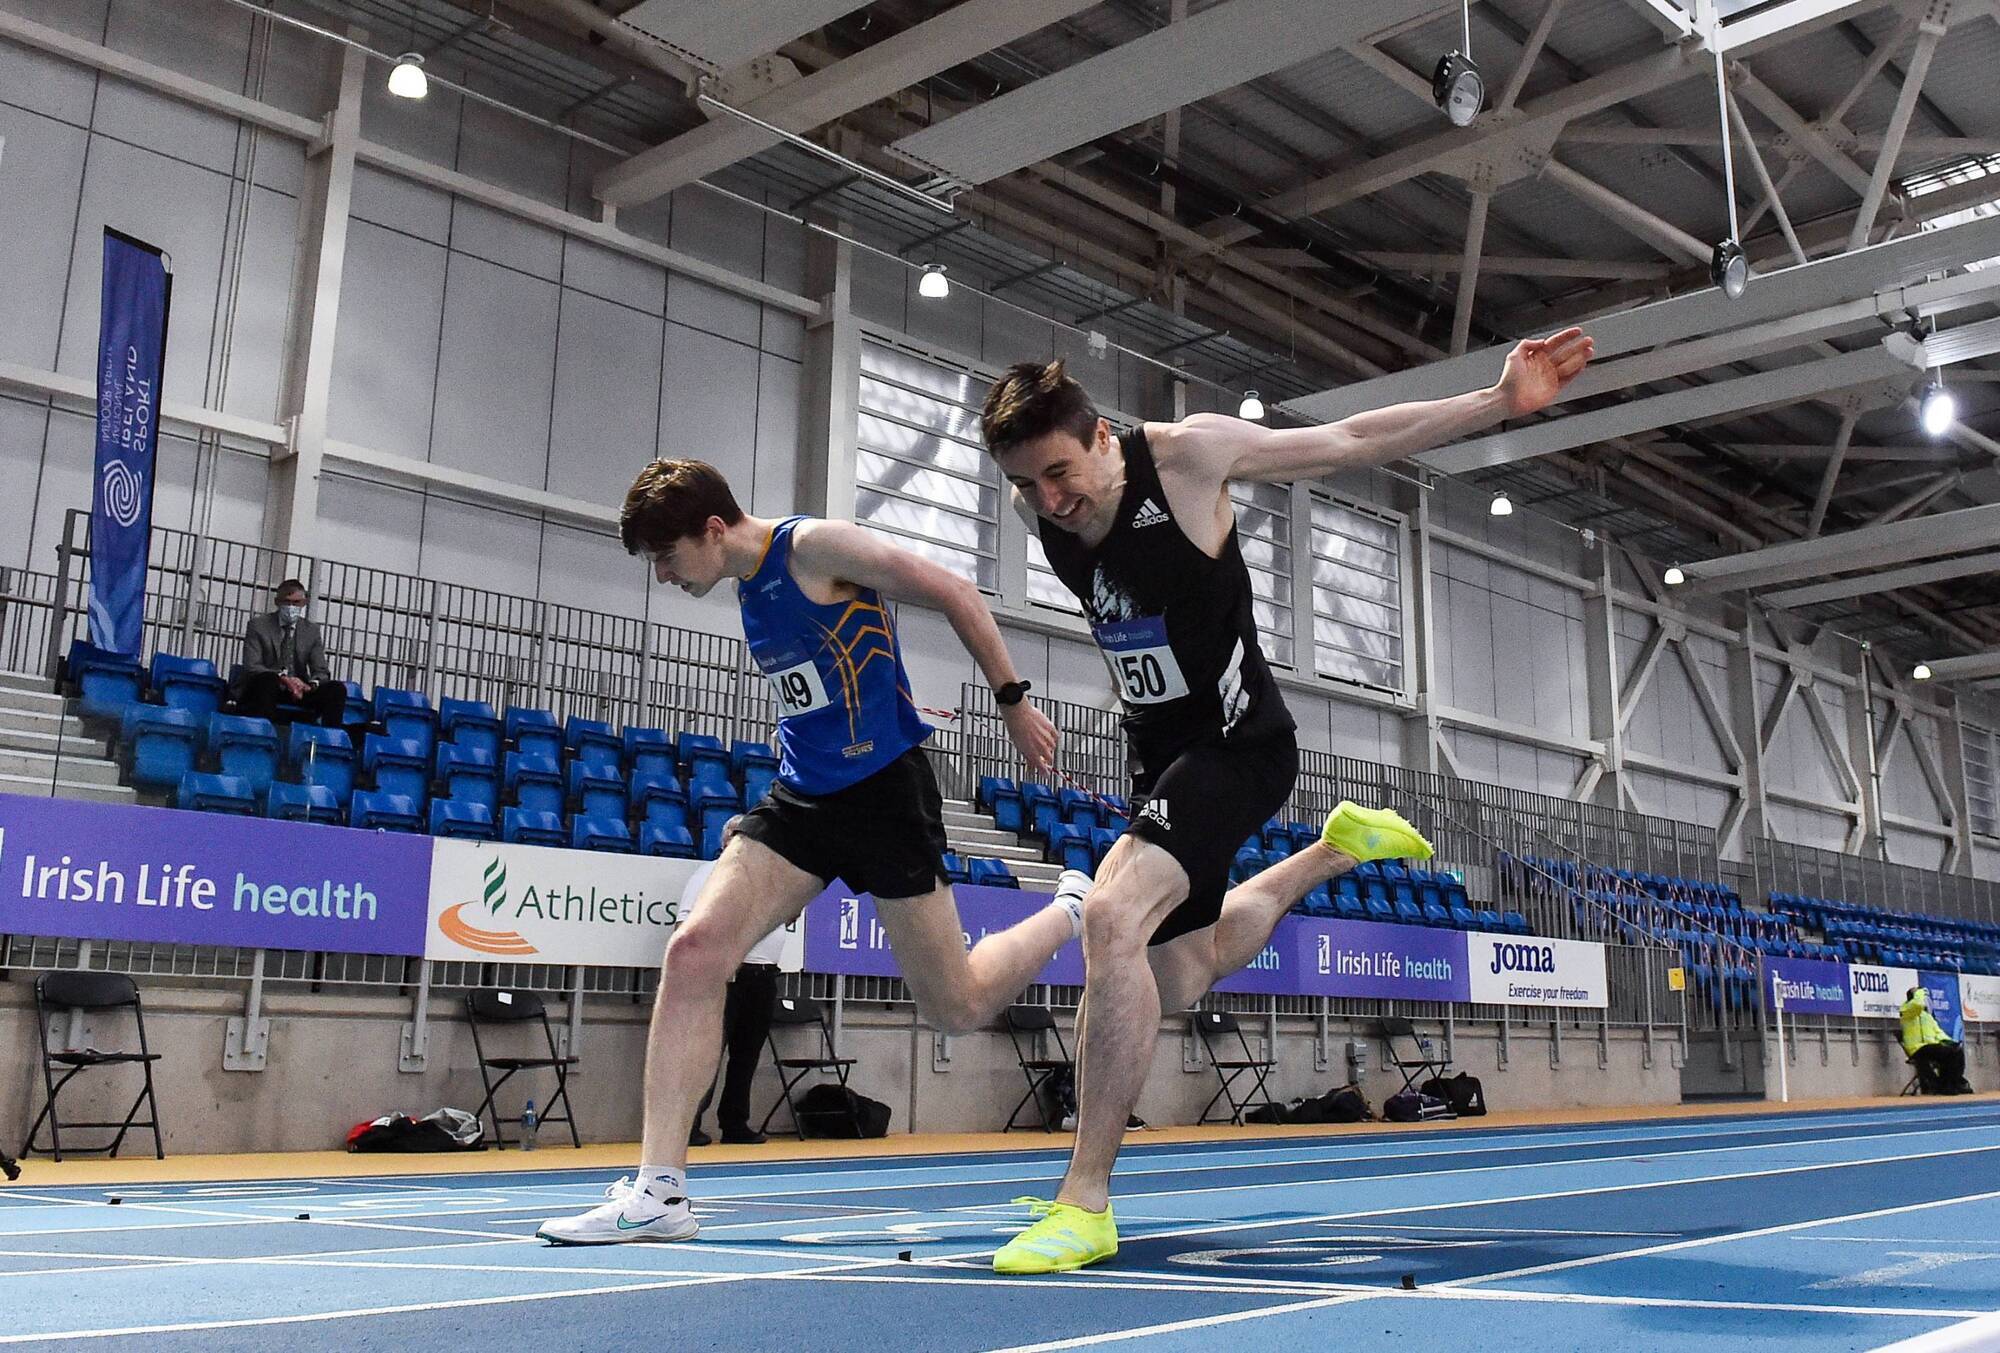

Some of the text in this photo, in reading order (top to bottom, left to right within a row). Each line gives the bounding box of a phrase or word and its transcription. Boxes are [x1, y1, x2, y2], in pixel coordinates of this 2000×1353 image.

[1132, 513, 1169, 529] adidas
[22, 855, 378, 921] Irish Life health
[515, 884, 679, 926] Athletics
[1336, 949, 1452, 981] Irish Life health
[1508, 983, 1589, 1002] Exercise your freedom
[1800, 980, 1815, 1000] Life
